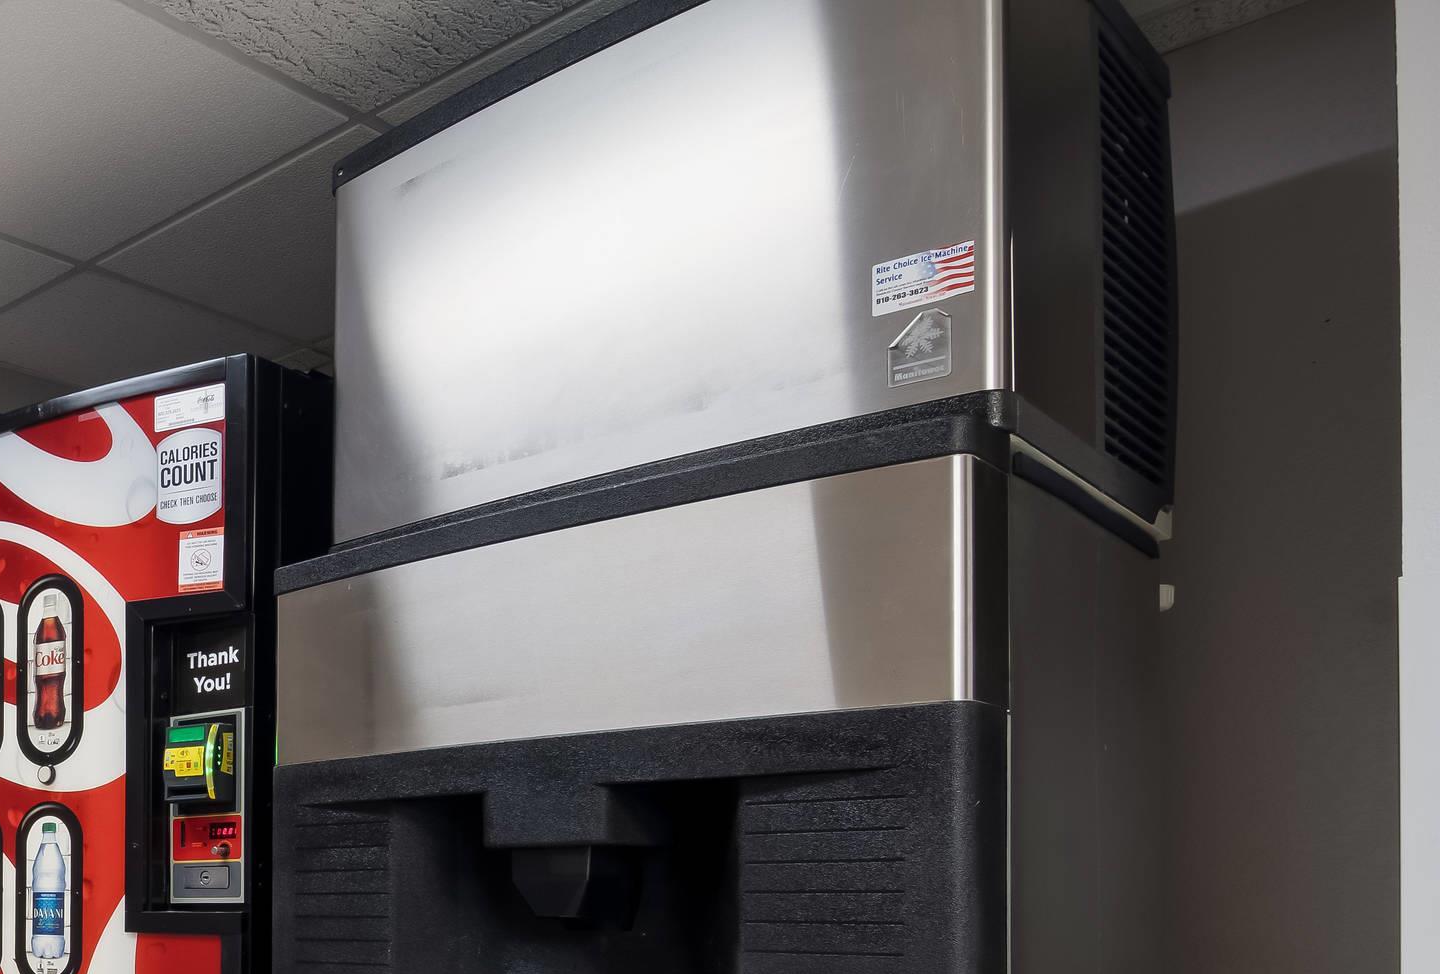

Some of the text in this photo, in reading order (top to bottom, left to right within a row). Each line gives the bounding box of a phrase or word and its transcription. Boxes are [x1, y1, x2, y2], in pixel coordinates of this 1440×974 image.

[876, 244, 968, 275] Rite Choice Ice Machine
[876, 272, 903, 286] Service
[894, 364, 946, 381] Manitowoc
[160, 441, 218, 466] CALORIES
[160, 458, 218, 489] COUNT
[160, 492, 217, 510] CHECK THEN CHOOSE
[35, 650, 65, 668] Coke
[186, 645, 240, 670] Thank
[193, 672, 231, 694] You!
[33, 907, 64, 920] DASANI
